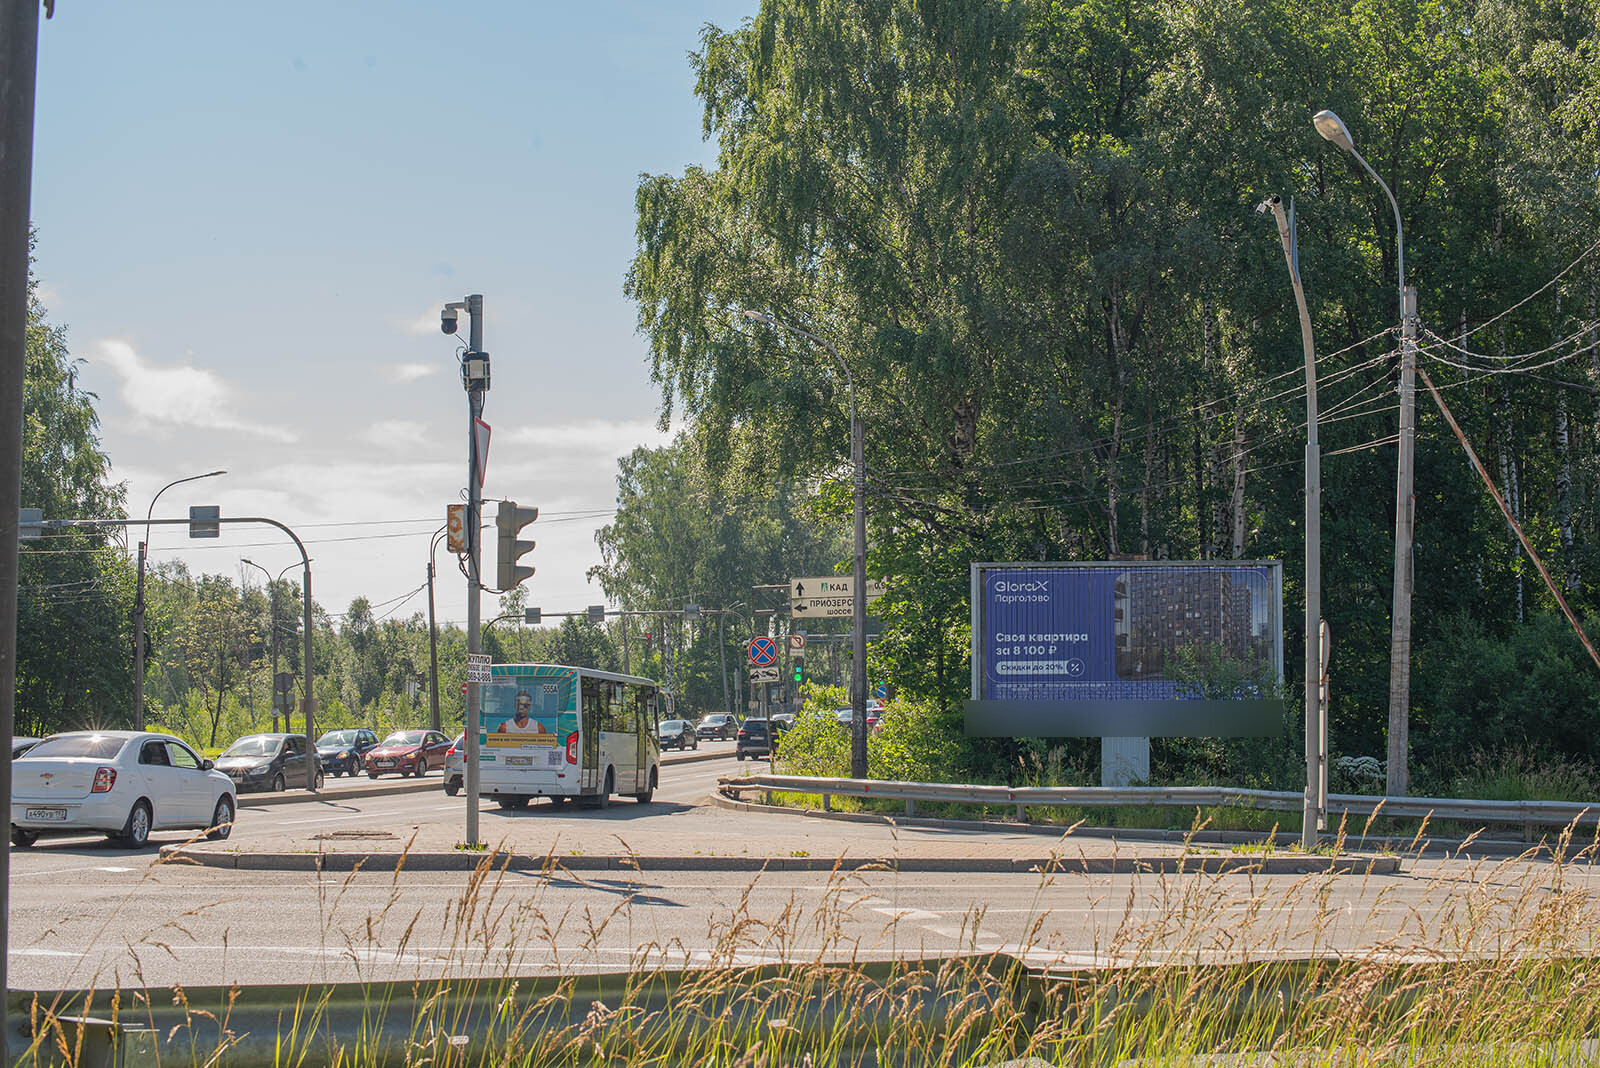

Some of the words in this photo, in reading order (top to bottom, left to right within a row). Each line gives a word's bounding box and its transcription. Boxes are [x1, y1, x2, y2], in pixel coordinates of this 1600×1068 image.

[829, 583, 848, 591] КАД
[994, 581, 1048, 591] GloraX
[810, 599, 854, 607] ПРИОЗЕРС
[994, 594, 1050, 604] Парголово
[996, 632, 1025, 642] Своя
[1029, 633, 1089, 644] квартира
[996, 647, 1010, 655] за
